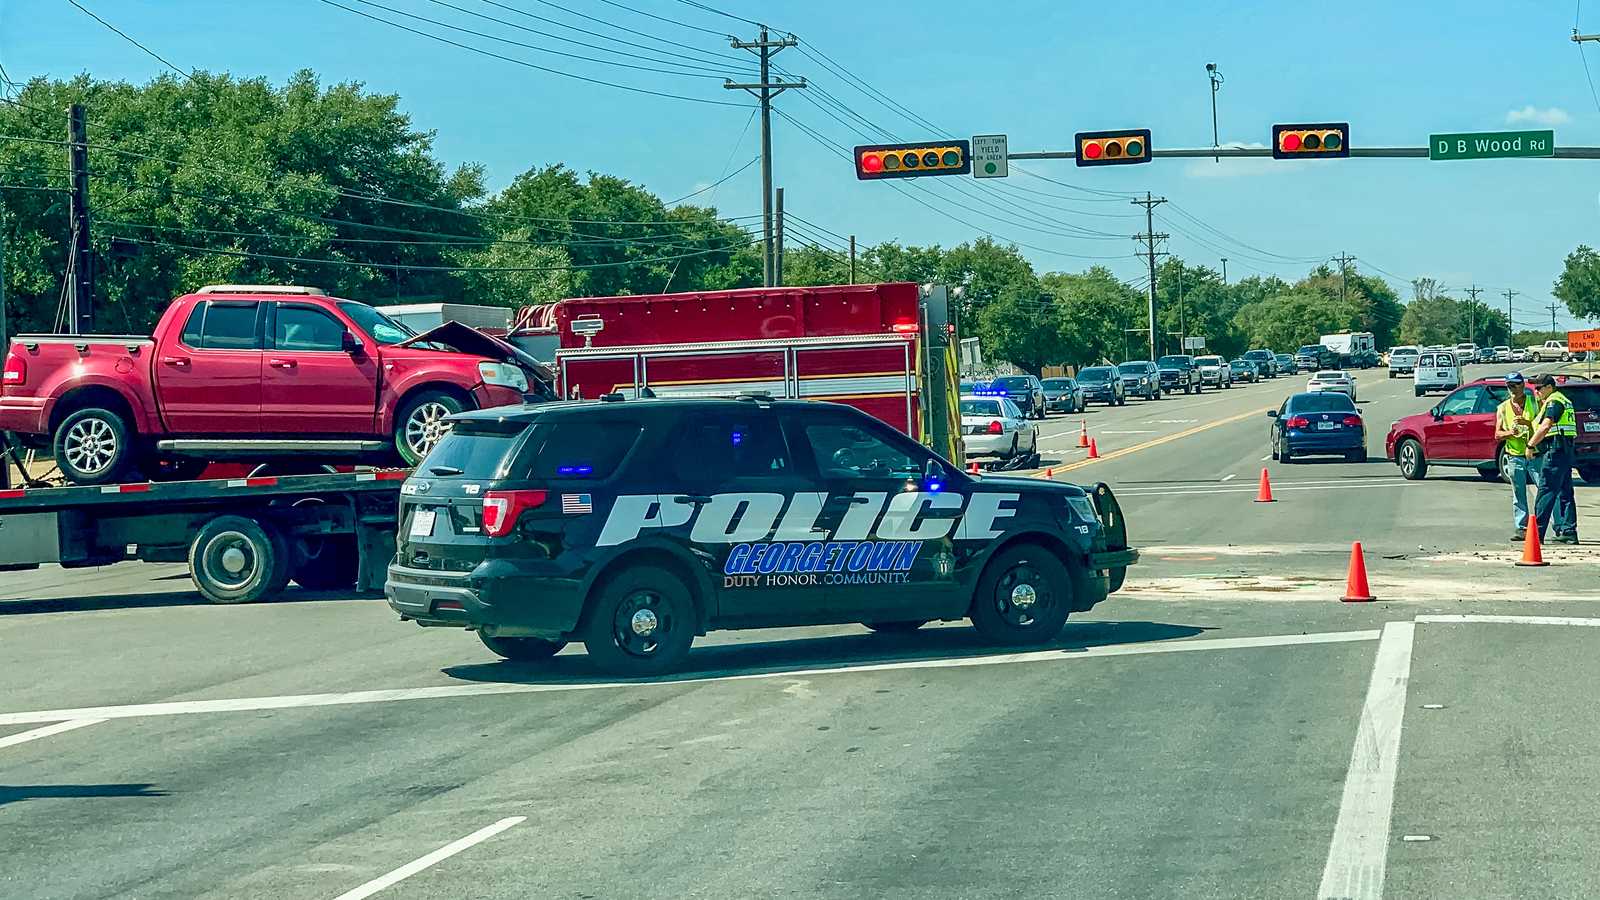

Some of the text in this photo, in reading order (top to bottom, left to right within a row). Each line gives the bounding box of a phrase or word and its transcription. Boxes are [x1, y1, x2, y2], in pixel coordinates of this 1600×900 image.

[1438, 137, 1545, 154] D B Wood Rd
[462, 484, 480, 494] 78
[595, 491, 1021, 547] POLICE
[1074, 524, 1089, 535] 78
[724, 541, 923, 574] GEORGETOWN
[723, 575, 760, 588] DUTY
